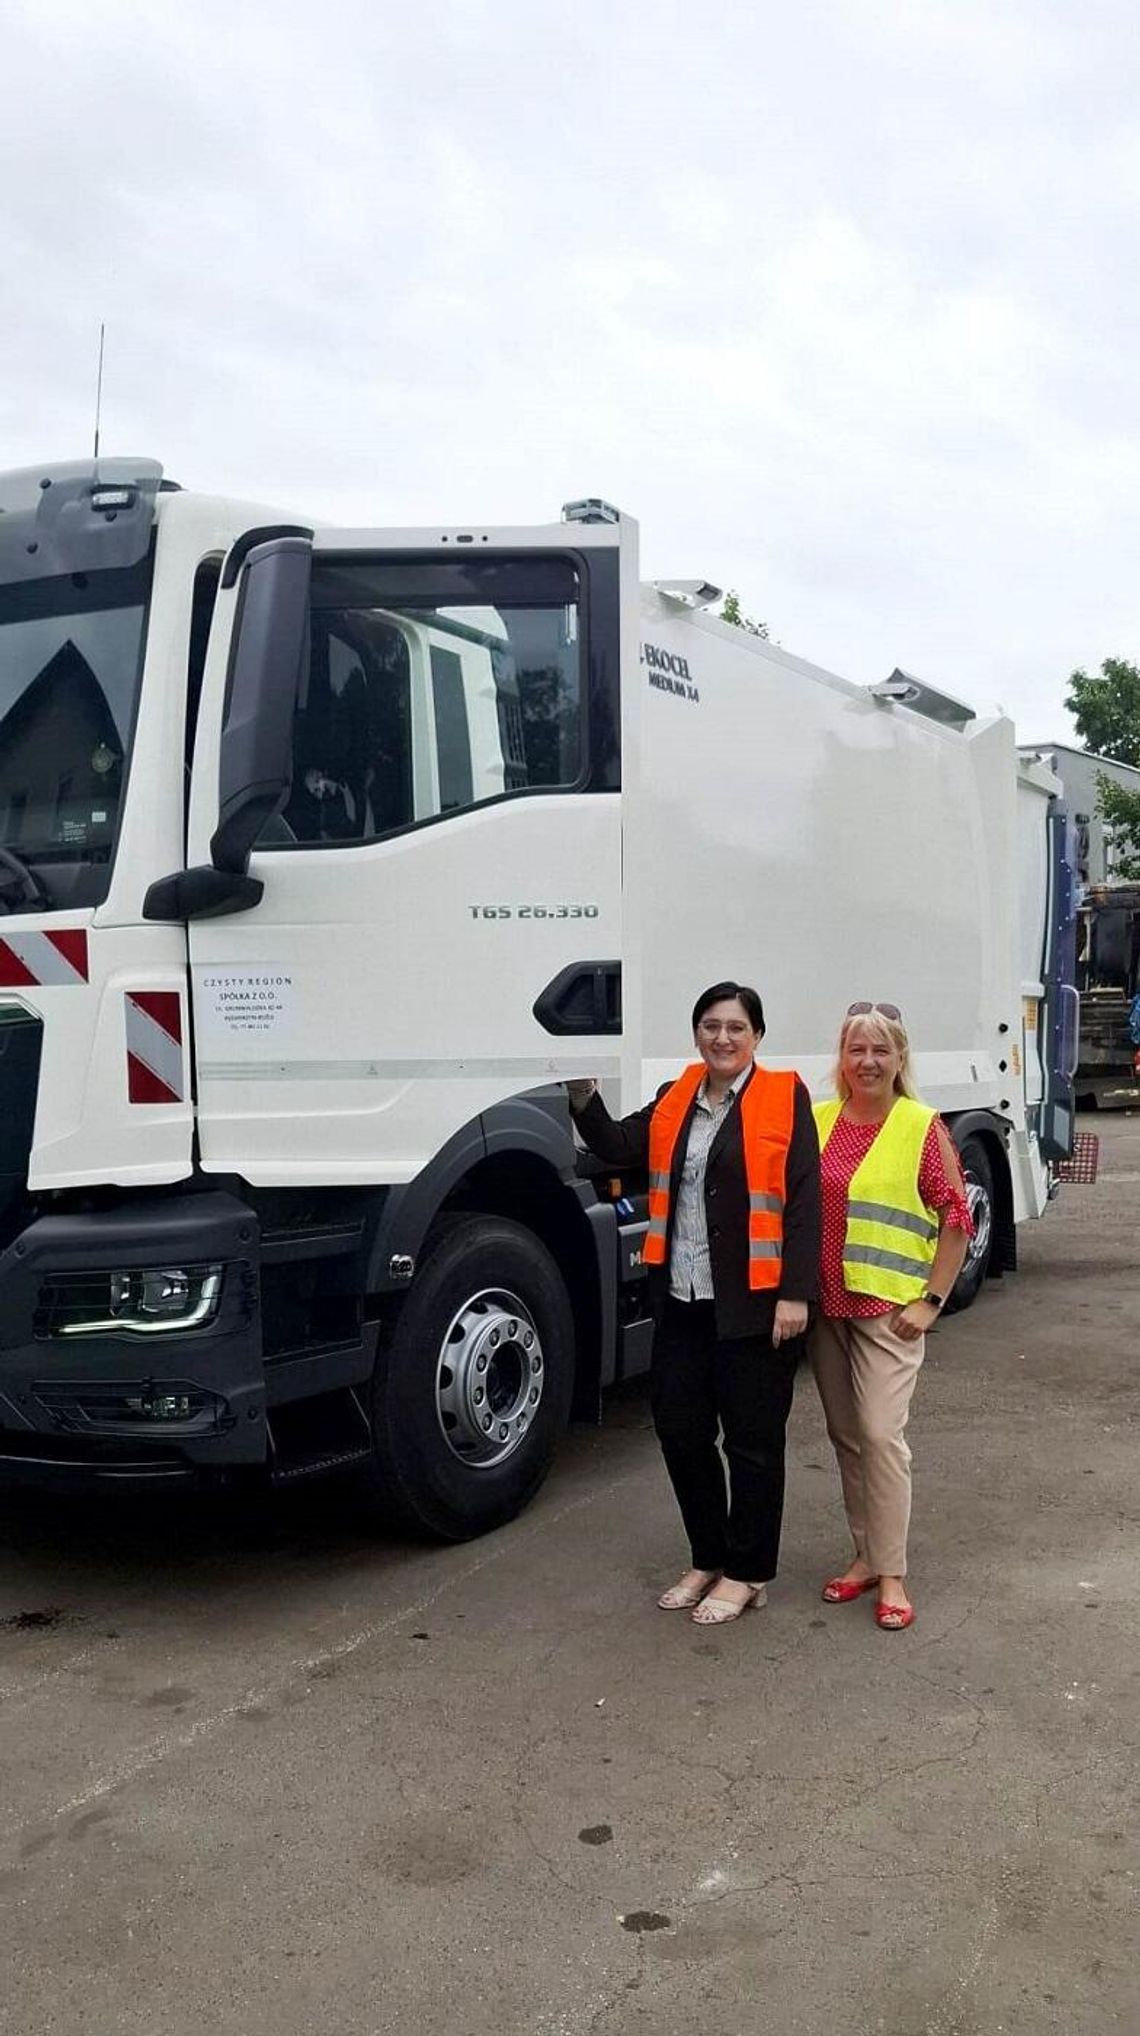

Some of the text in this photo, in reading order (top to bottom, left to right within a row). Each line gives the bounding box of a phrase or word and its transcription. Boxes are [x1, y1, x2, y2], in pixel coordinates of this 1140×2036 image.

[644, 643, 692, 681] EKOCEL
[468, 905, 599, 919] TGS 26.330
[203, 977, 292, 987] CZYSTY REGION
